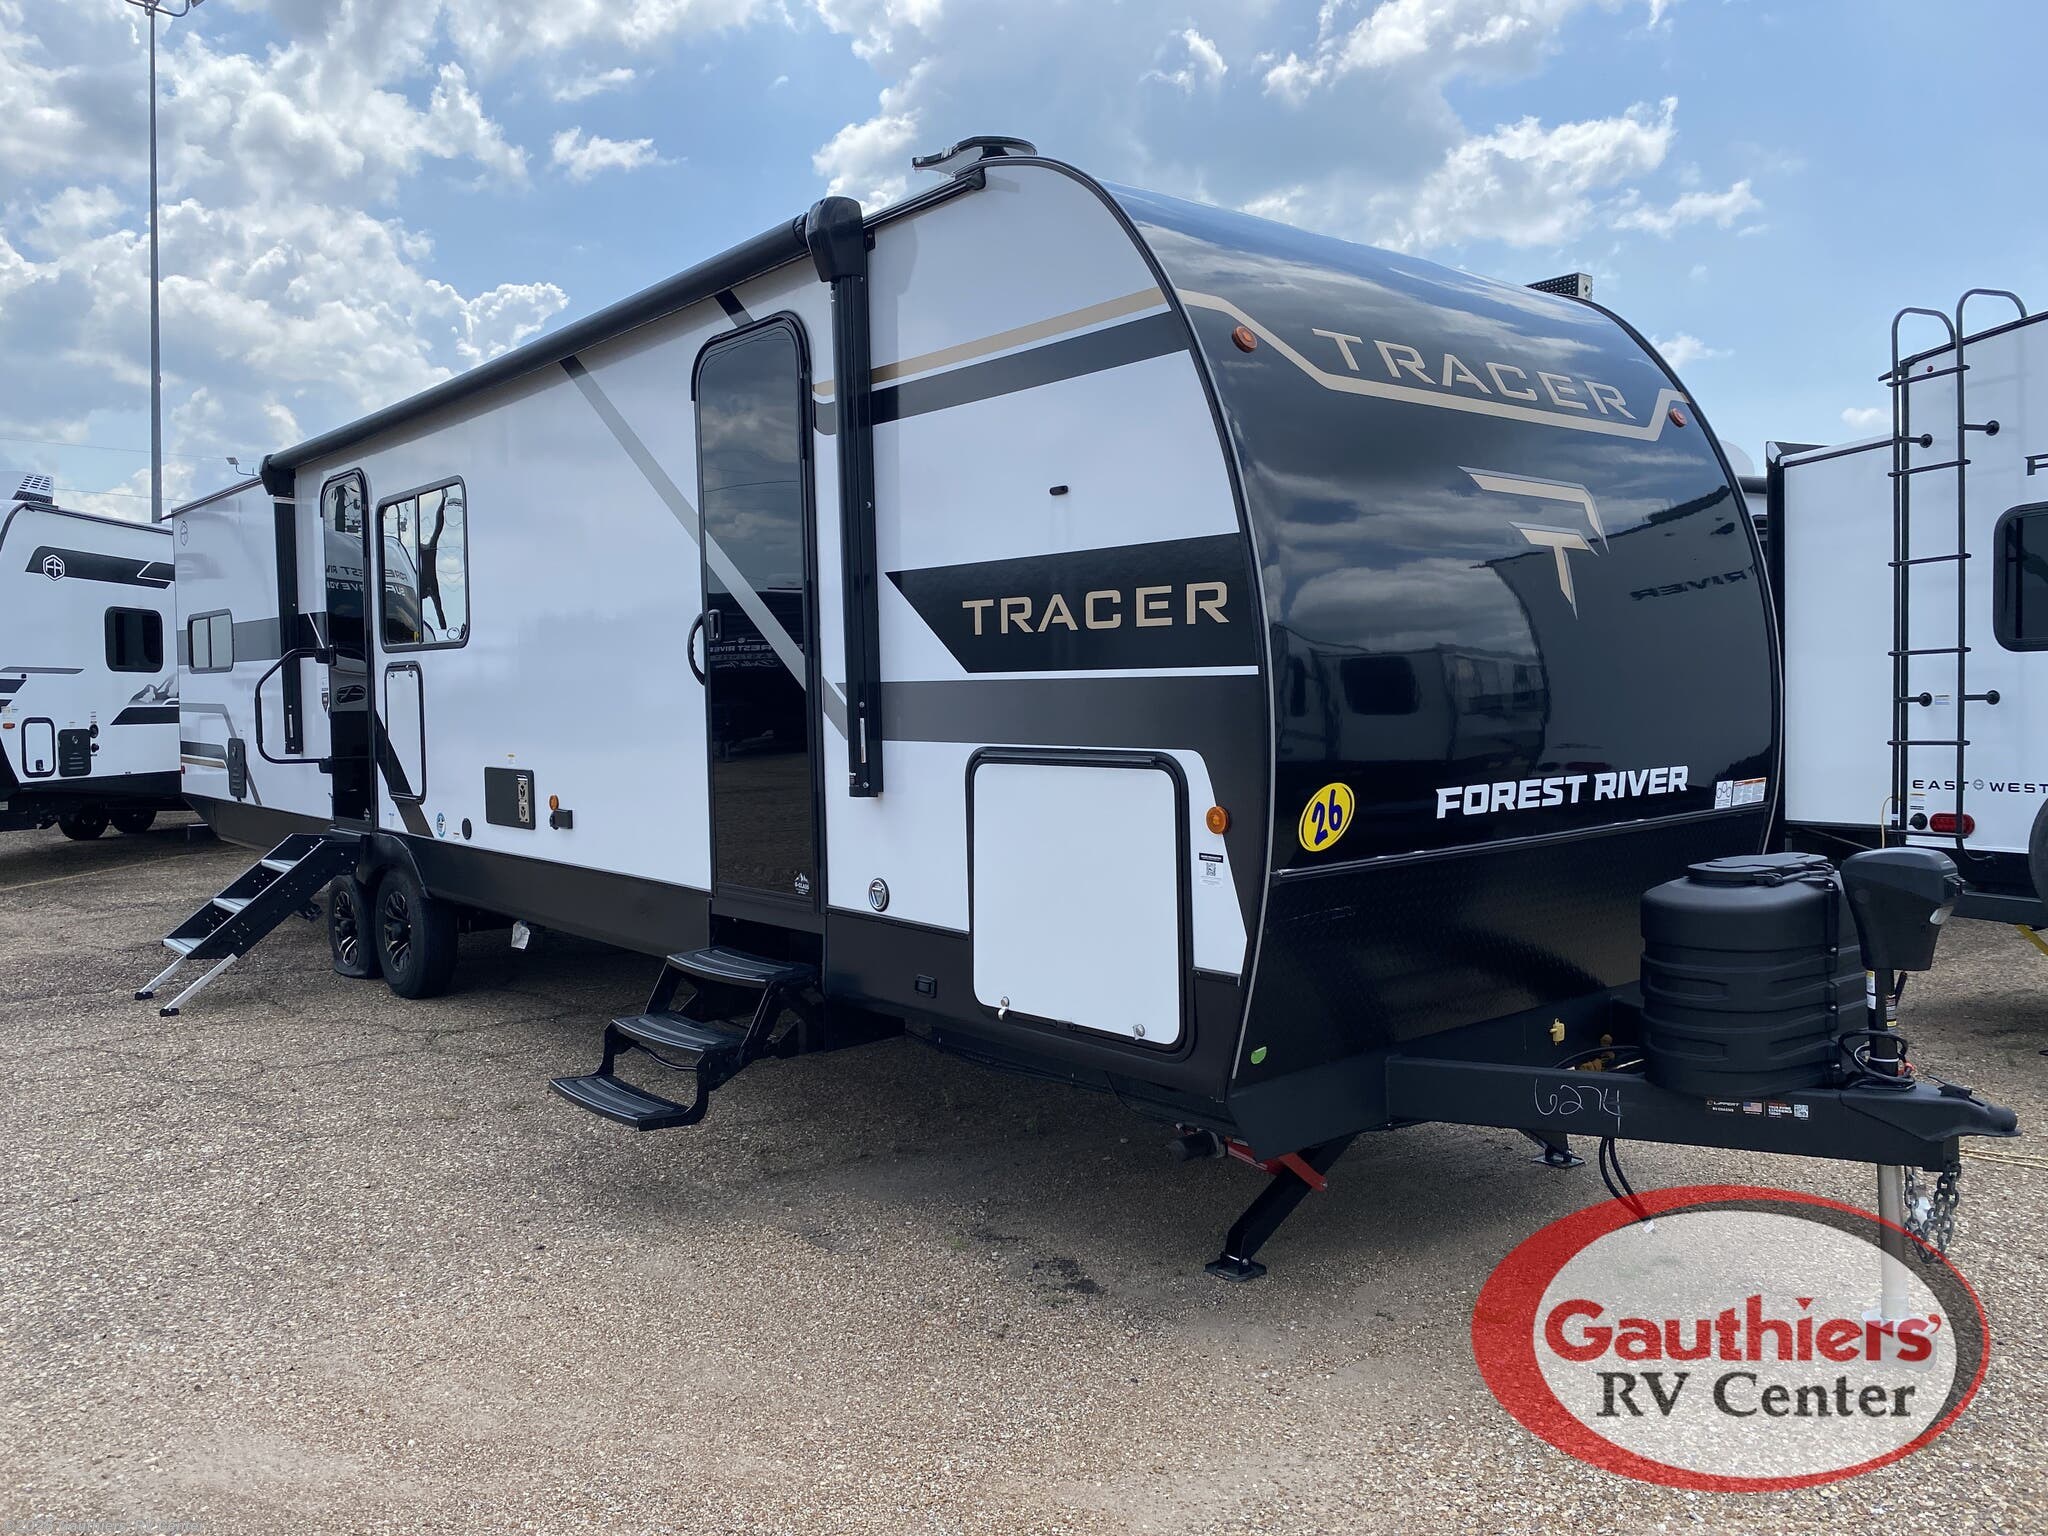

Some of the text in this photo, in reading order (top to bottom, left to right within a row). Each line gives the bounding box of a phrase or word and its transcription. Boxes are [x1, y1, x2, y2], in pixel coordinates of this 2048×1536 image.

[1312, 328, 1637, 420] TRACER
[962, 581, 1230, 636] TRACER
[1436, 774, 1588, 819] FOREST
[1594, 765, 1689, 801] RIVER
[1989, 782, 2048, 793] WEST
[1311, 789, 1343, 846] 26
